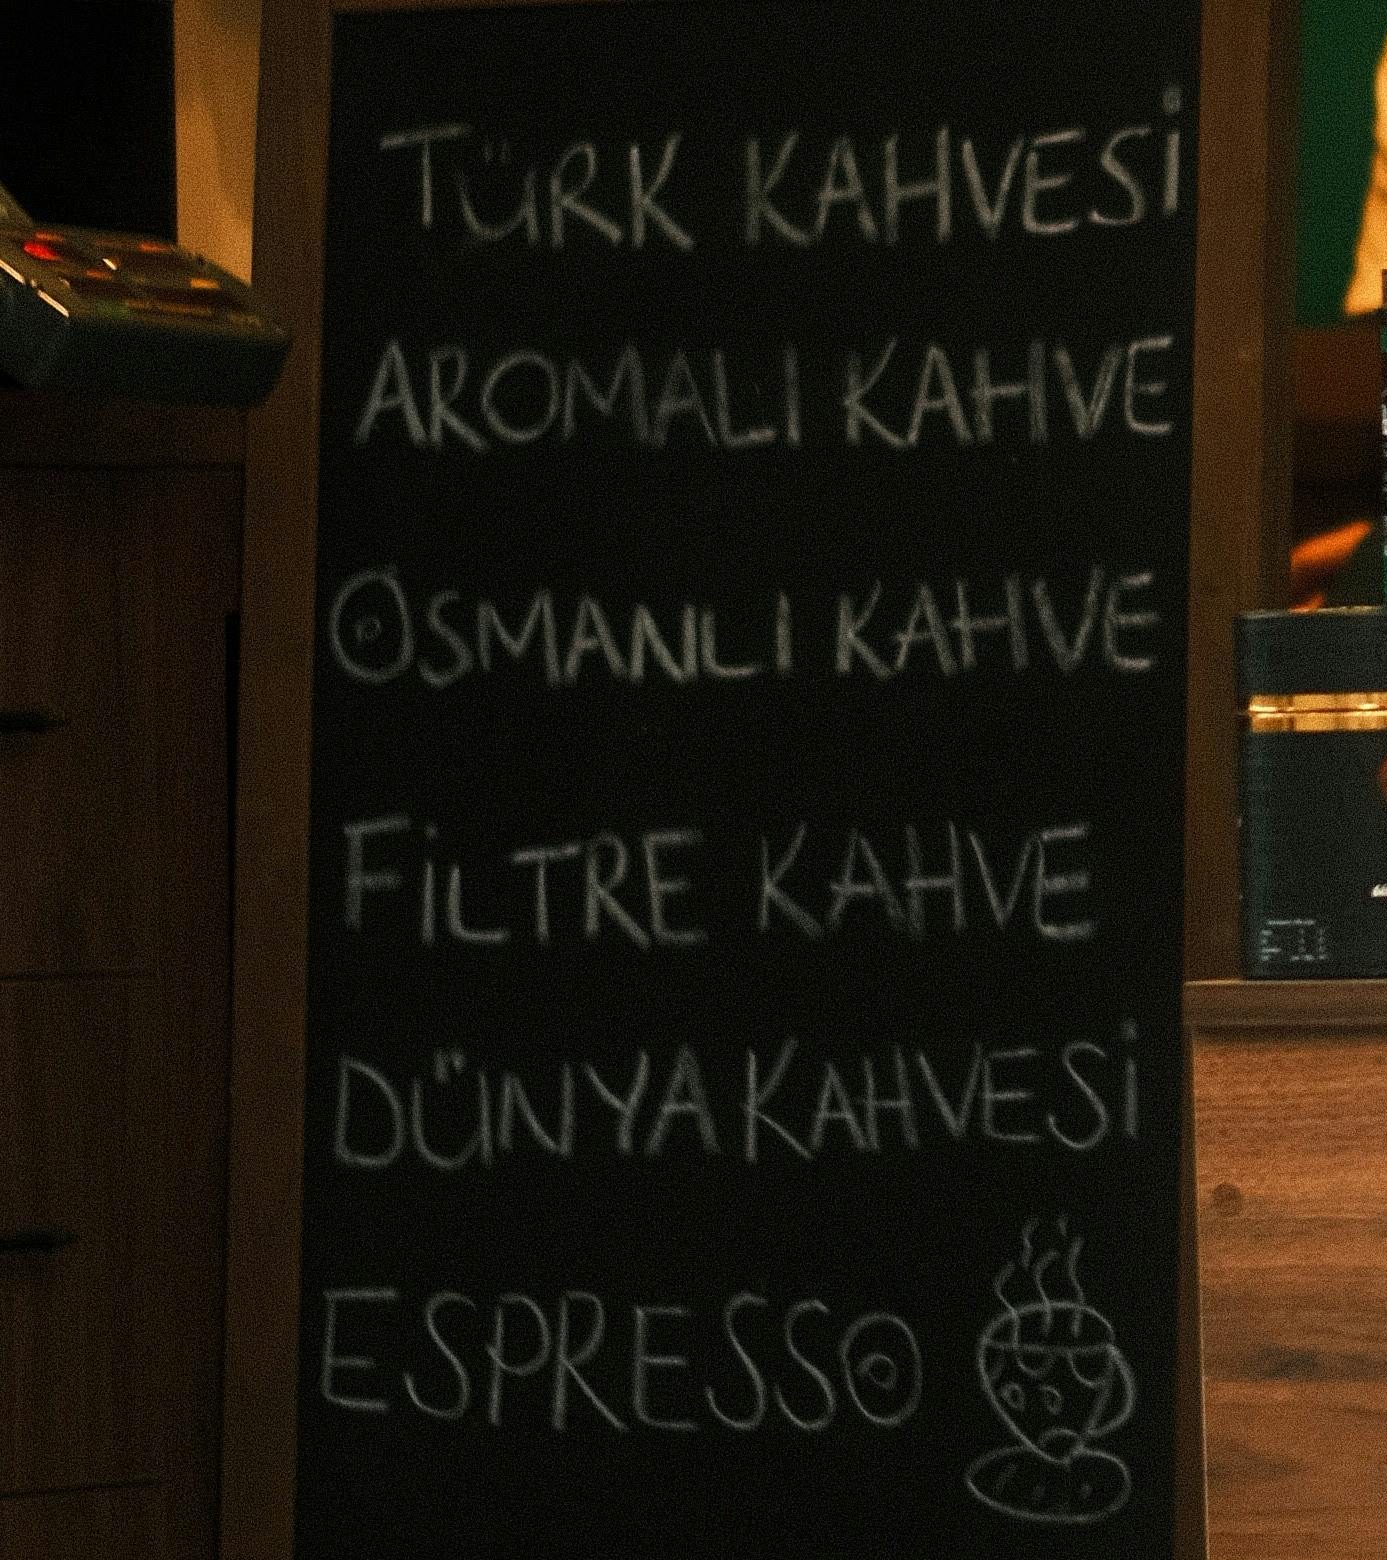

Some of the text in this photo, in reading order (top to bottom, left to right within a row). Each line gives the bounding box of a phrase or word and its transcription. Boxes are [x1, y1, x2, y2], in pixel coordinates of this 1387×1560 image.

[355, 335, 1176, 453] AROMALI KAHVE
[330, 565, 1160, 687] OSMANLI KAHVE
[757, 819, 1096, 941] KAHVE
[321, 1288, 924, 1431] ESPRESSO
